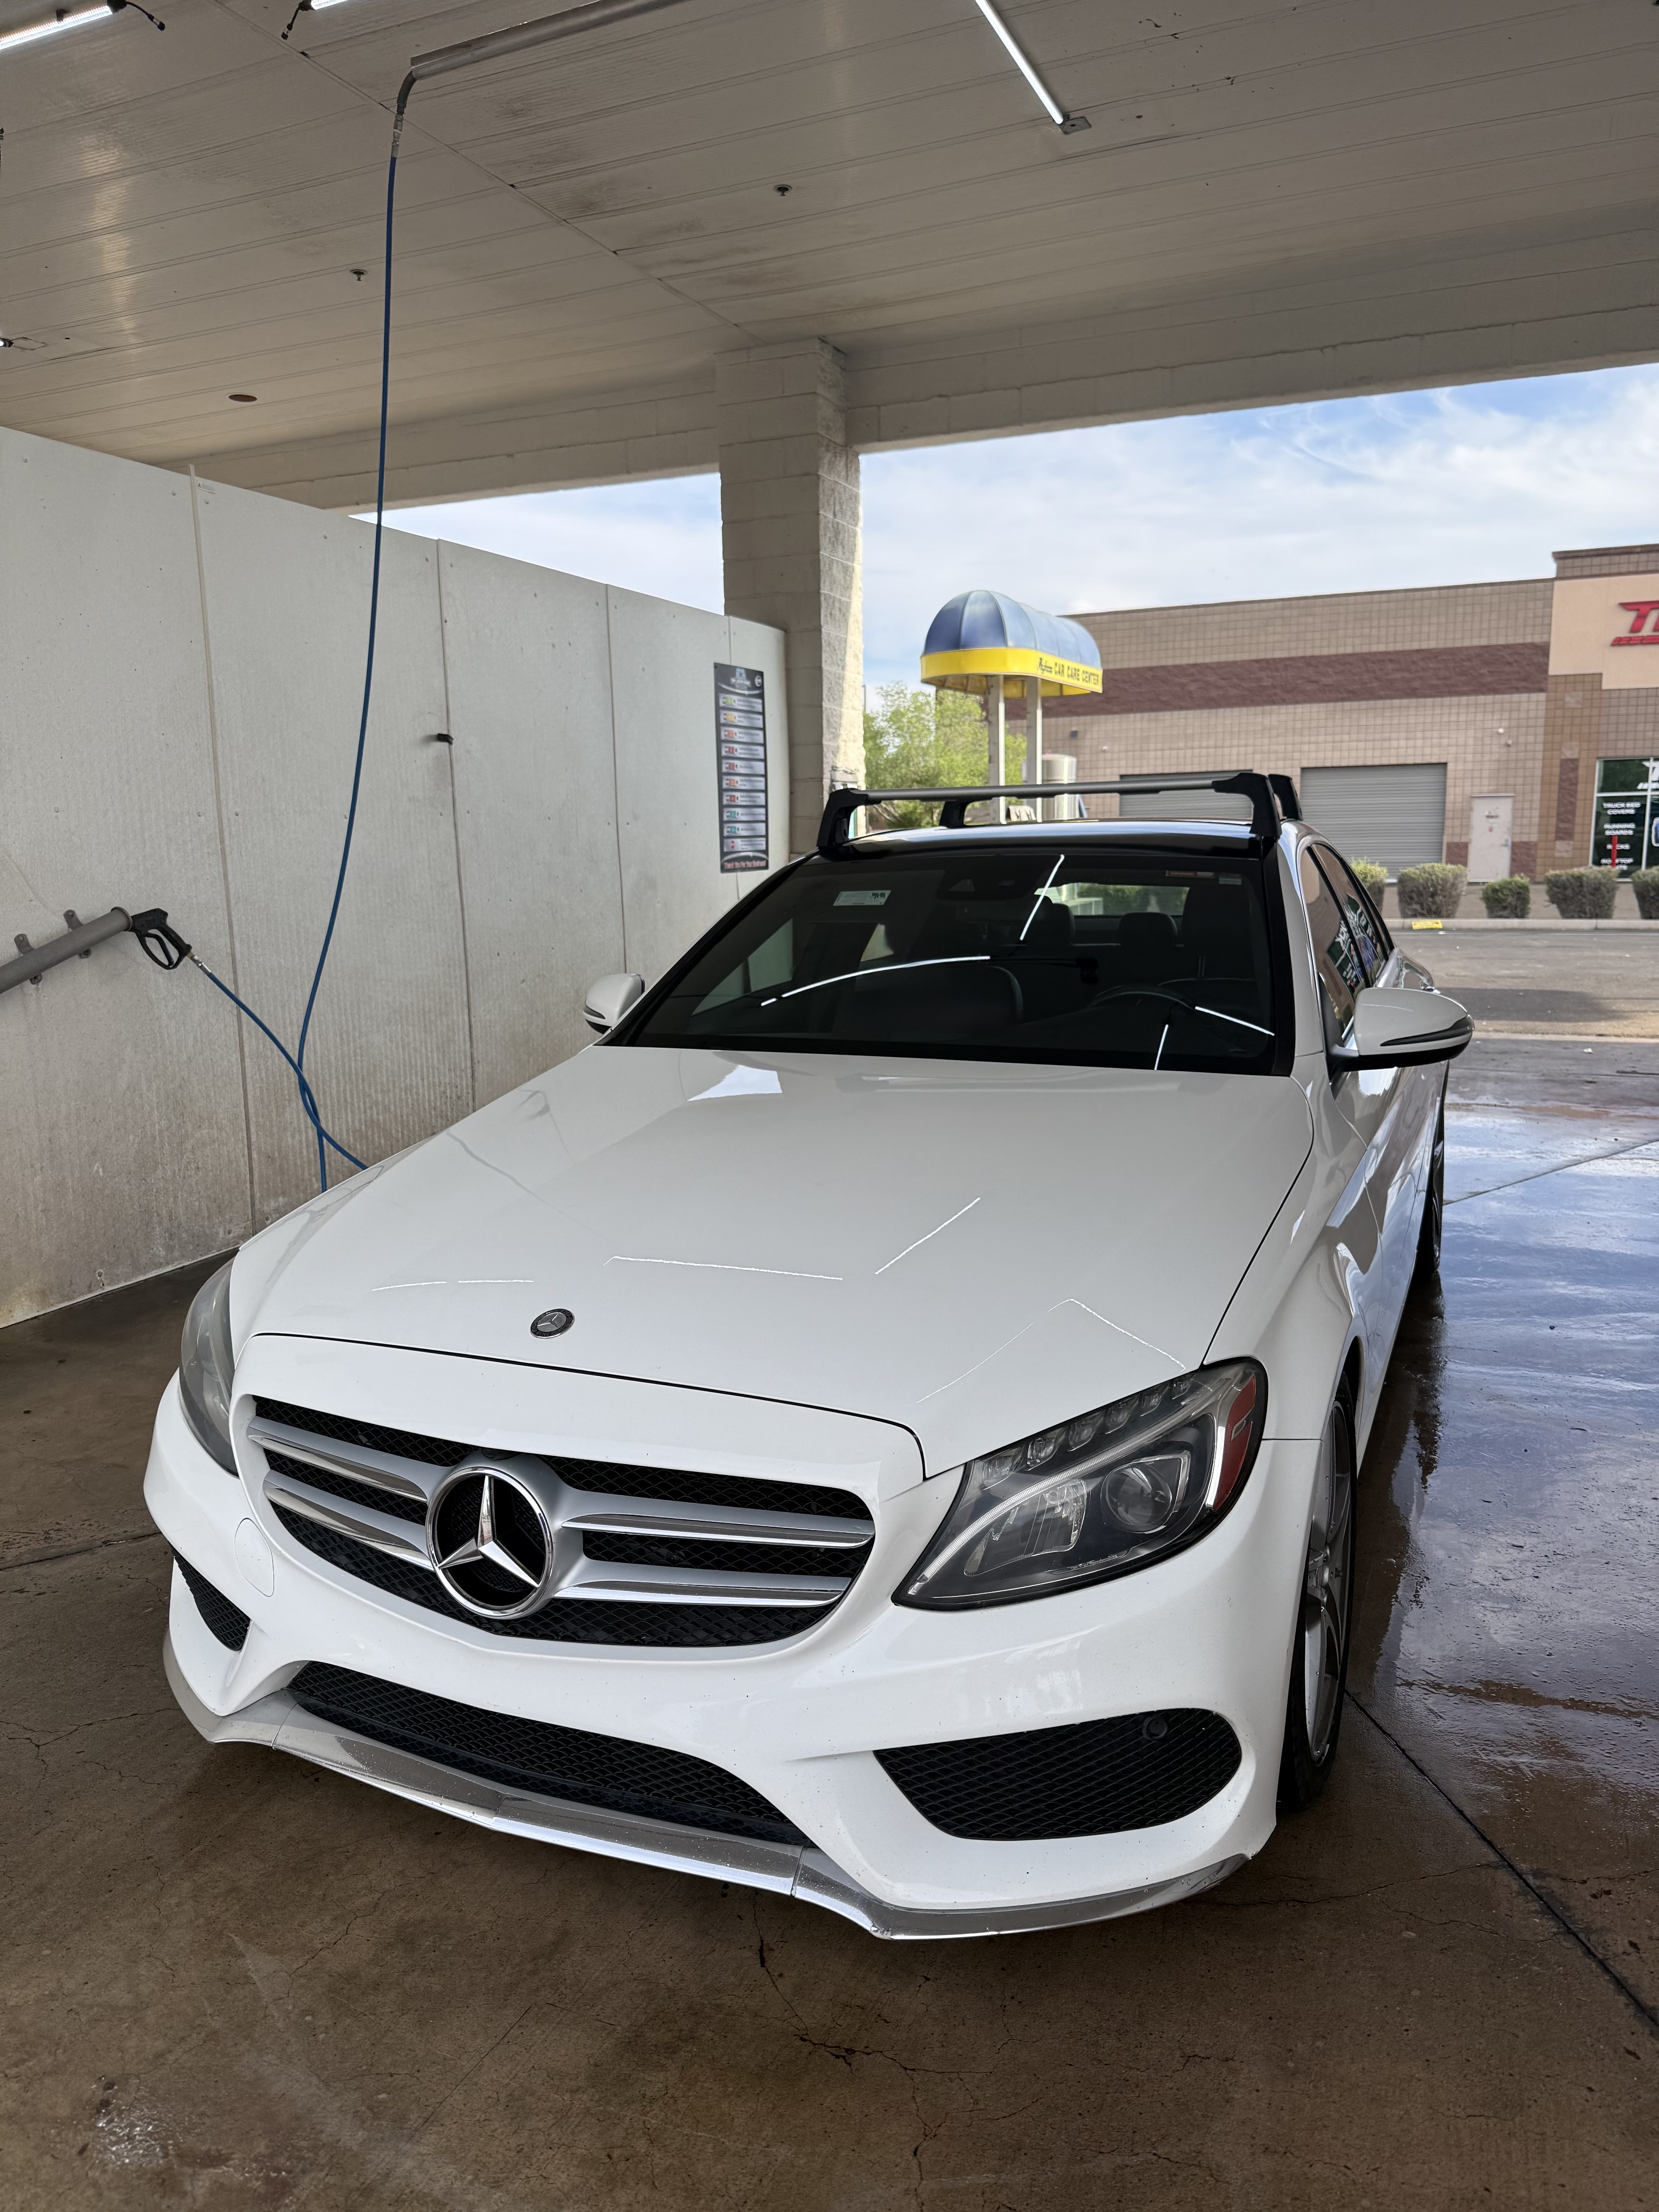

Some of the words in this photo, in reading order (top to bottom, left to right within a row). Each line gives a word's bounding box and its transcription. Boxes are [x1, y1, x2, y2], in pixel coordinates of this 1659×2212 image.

[1054, 662, 1065, 677] CAR
[1067, 666, 1080, 682] CARE
[1082, 670, 1099, 685] CENTER
